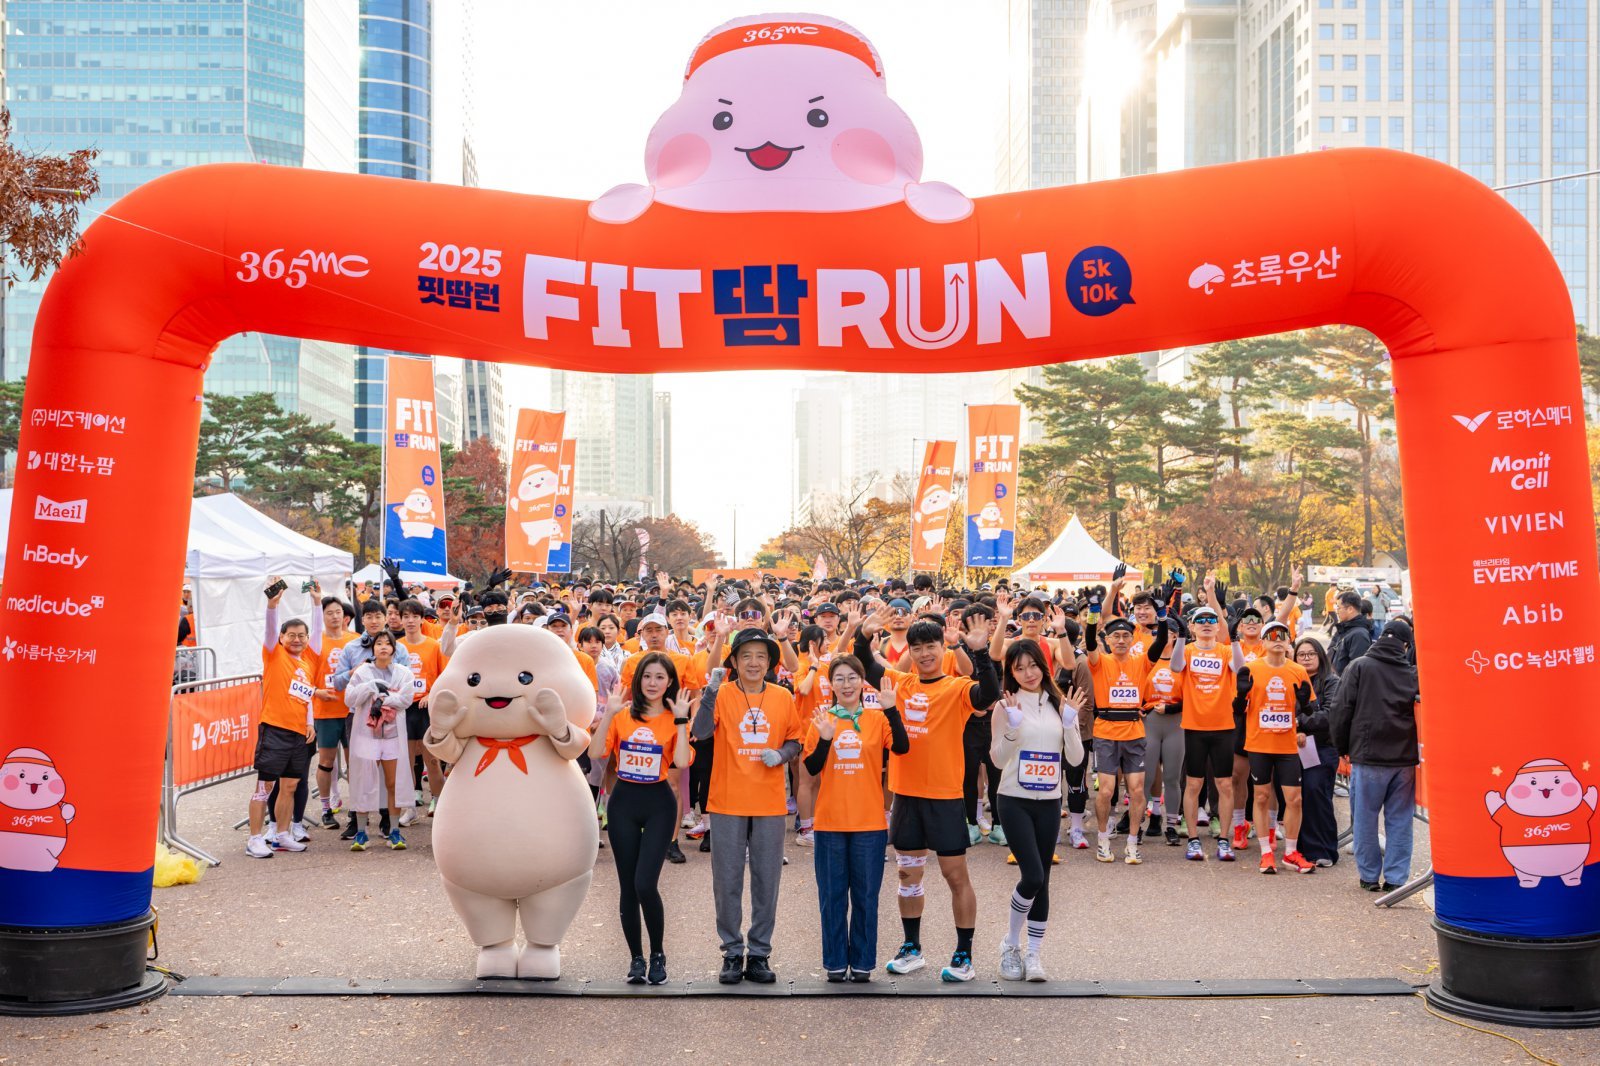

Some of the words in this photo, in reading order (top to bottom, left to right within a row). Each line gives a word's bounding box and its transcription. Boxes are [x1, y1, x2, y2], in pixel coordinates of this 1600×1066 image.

[236, 248, 370, 289] 365mc
[418, 241, 502, 278] 2025
[1082, 258, 1112, 279] 5k
[1231, 246, 1341, 288] 초록우산
[417, 275, 500, 313] 핏땀런
[1080, 282, 1118, 304] 10k
[396, 398, 433, 434] FIT
[1497, 405, 1572, 430] 로하스메디
[976, 435, 1013, 460] FIT
[44, 452, 116, 476] 대한뉴팜
[1490, 451, 1550, 473] Monit
[1510, 470, 1549, 491] Cell
[38, 503, 82, 520] Maeil
[1485, 510, 1564, 534] VIVIEN
[23, 543, 89, 569] InBody
[7, 594, 92, 617] medicube
[1502, 603, 1563, 625] Abib
[17, 643, 97, 665] 아름다운가게
[1193, 658, 1220, 669] 0020
[292, 682, 313, 697] 0424
[1111, 689, 1137, 698] 0228
[208, 713, 249, 746] 대한뉴팜
[1261, 714, 1290, 723] 0408
[626, 754, 654, 768] 2119
[1025, 763, 1056, 776] 2120
